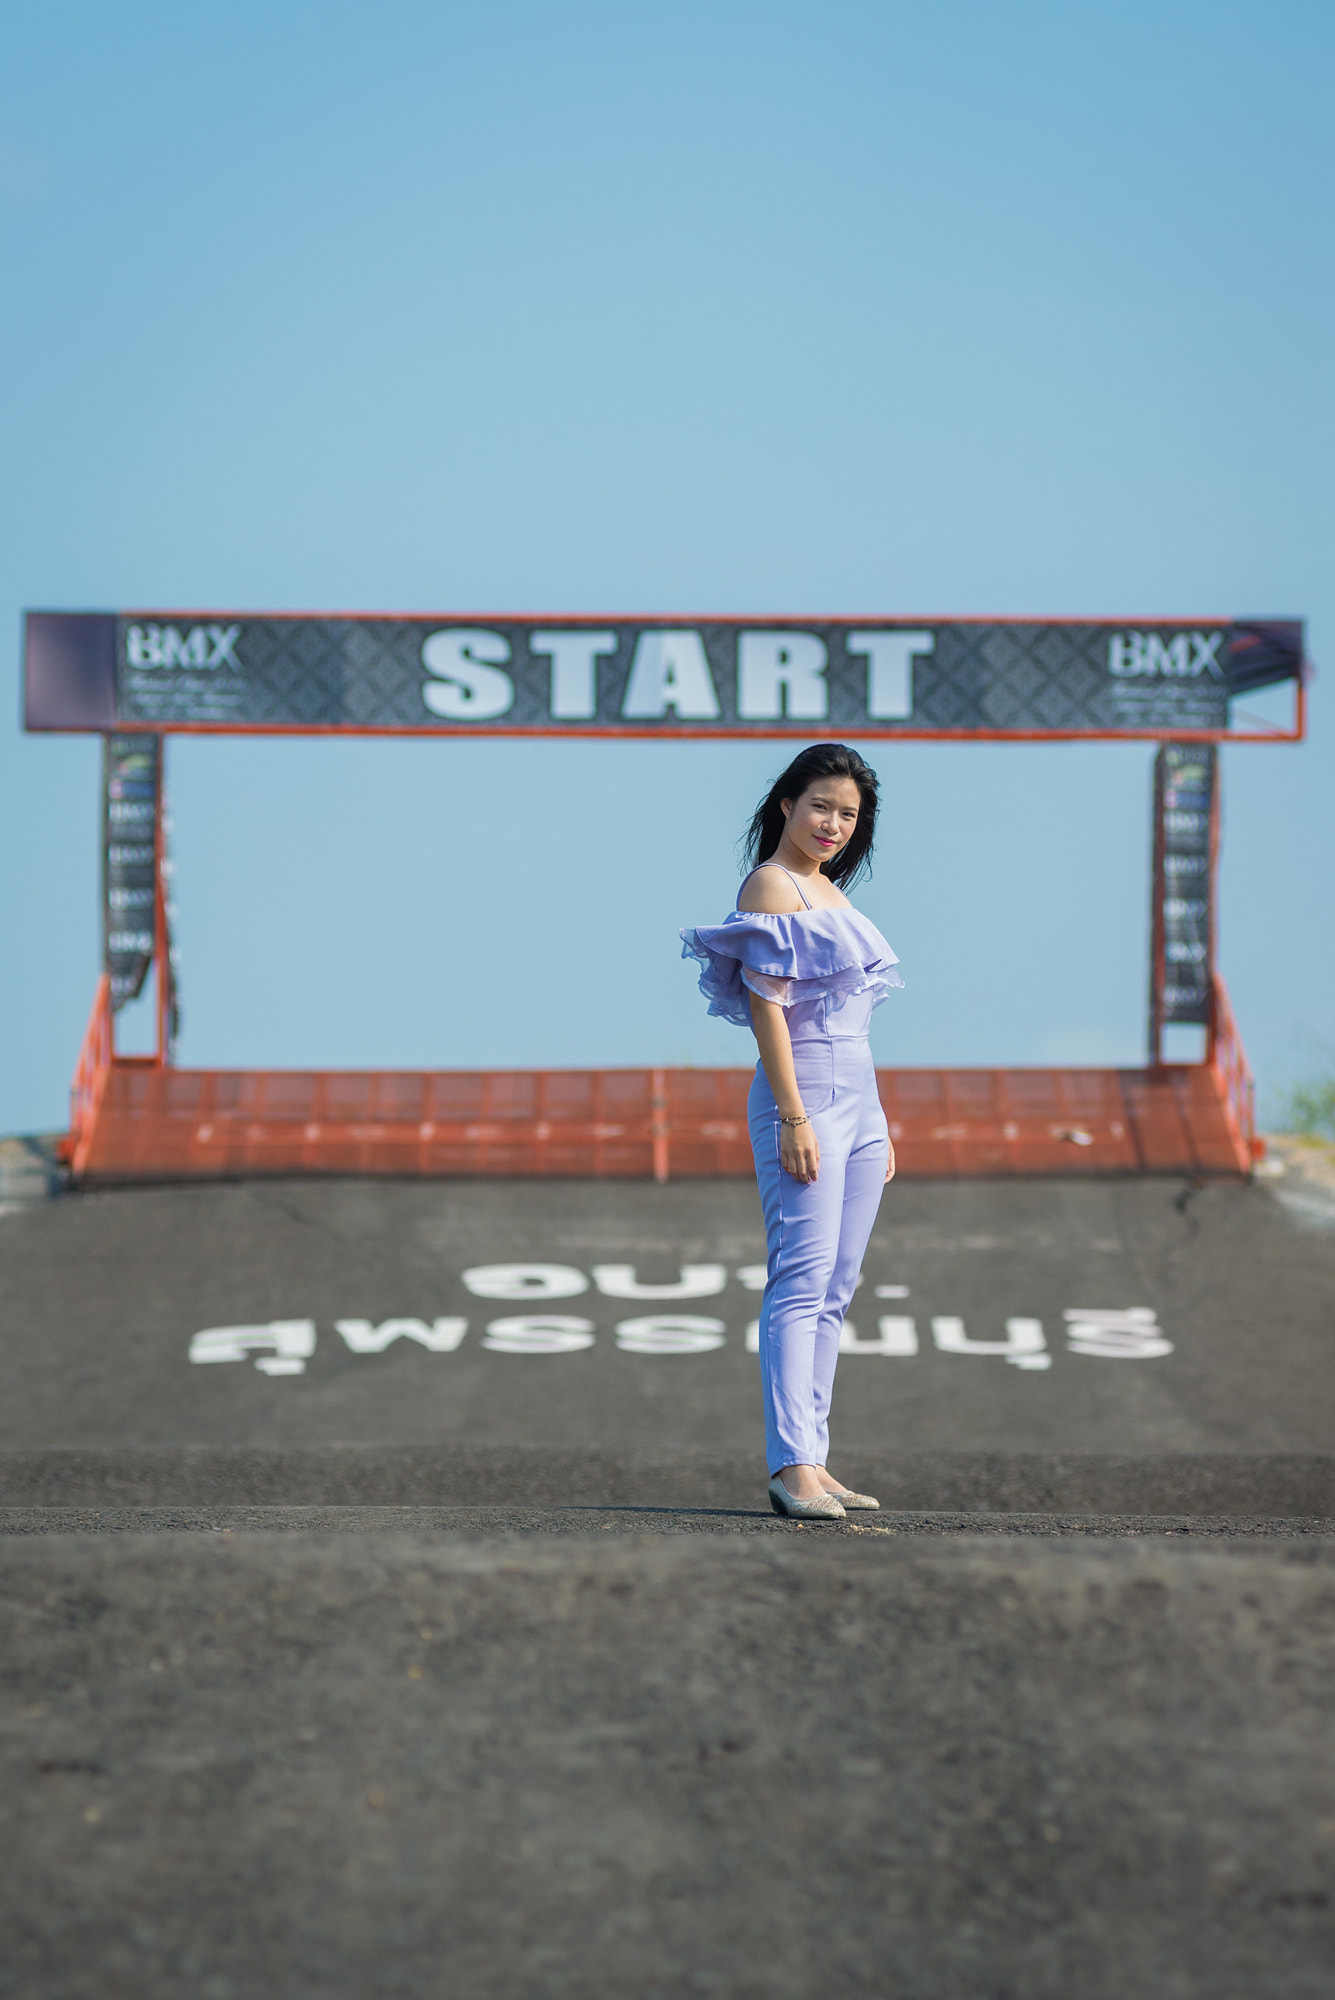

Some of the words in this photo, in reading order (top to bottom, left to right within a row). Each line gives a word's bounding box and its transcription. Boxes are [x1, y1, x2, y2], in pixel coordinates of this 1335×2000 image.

[126, 623, 244, 673] BMX
[1108, 630, 1228, 681] BMX
[423, 632, 932, 719] START
[461, 1263, 909, 1300] อบ.
